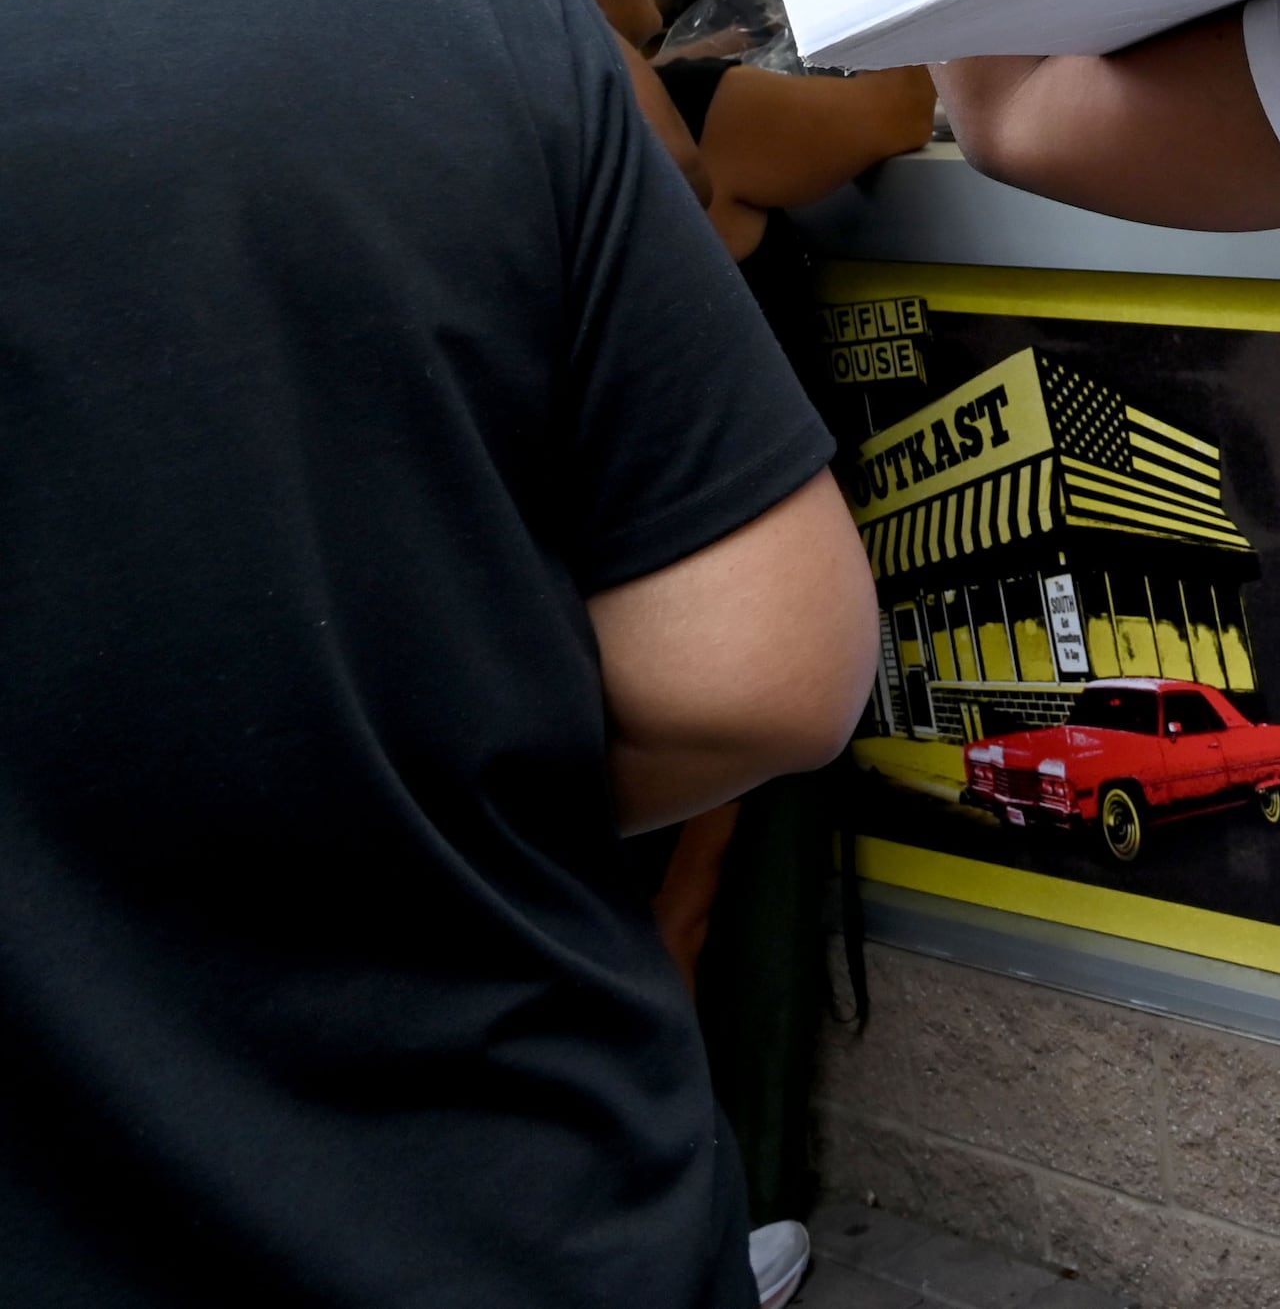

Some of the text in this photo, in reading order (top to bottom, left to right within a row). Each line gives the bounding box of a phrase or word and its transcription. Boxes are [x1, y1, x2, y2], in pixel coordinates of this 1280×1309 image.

[822, 300, 920, 341] FFLE
[833, 344, 914, 379] OUSE
[852, 384, 1010, 507] OUTKAST
[1050, 594, 1076, 614] SOUTH
